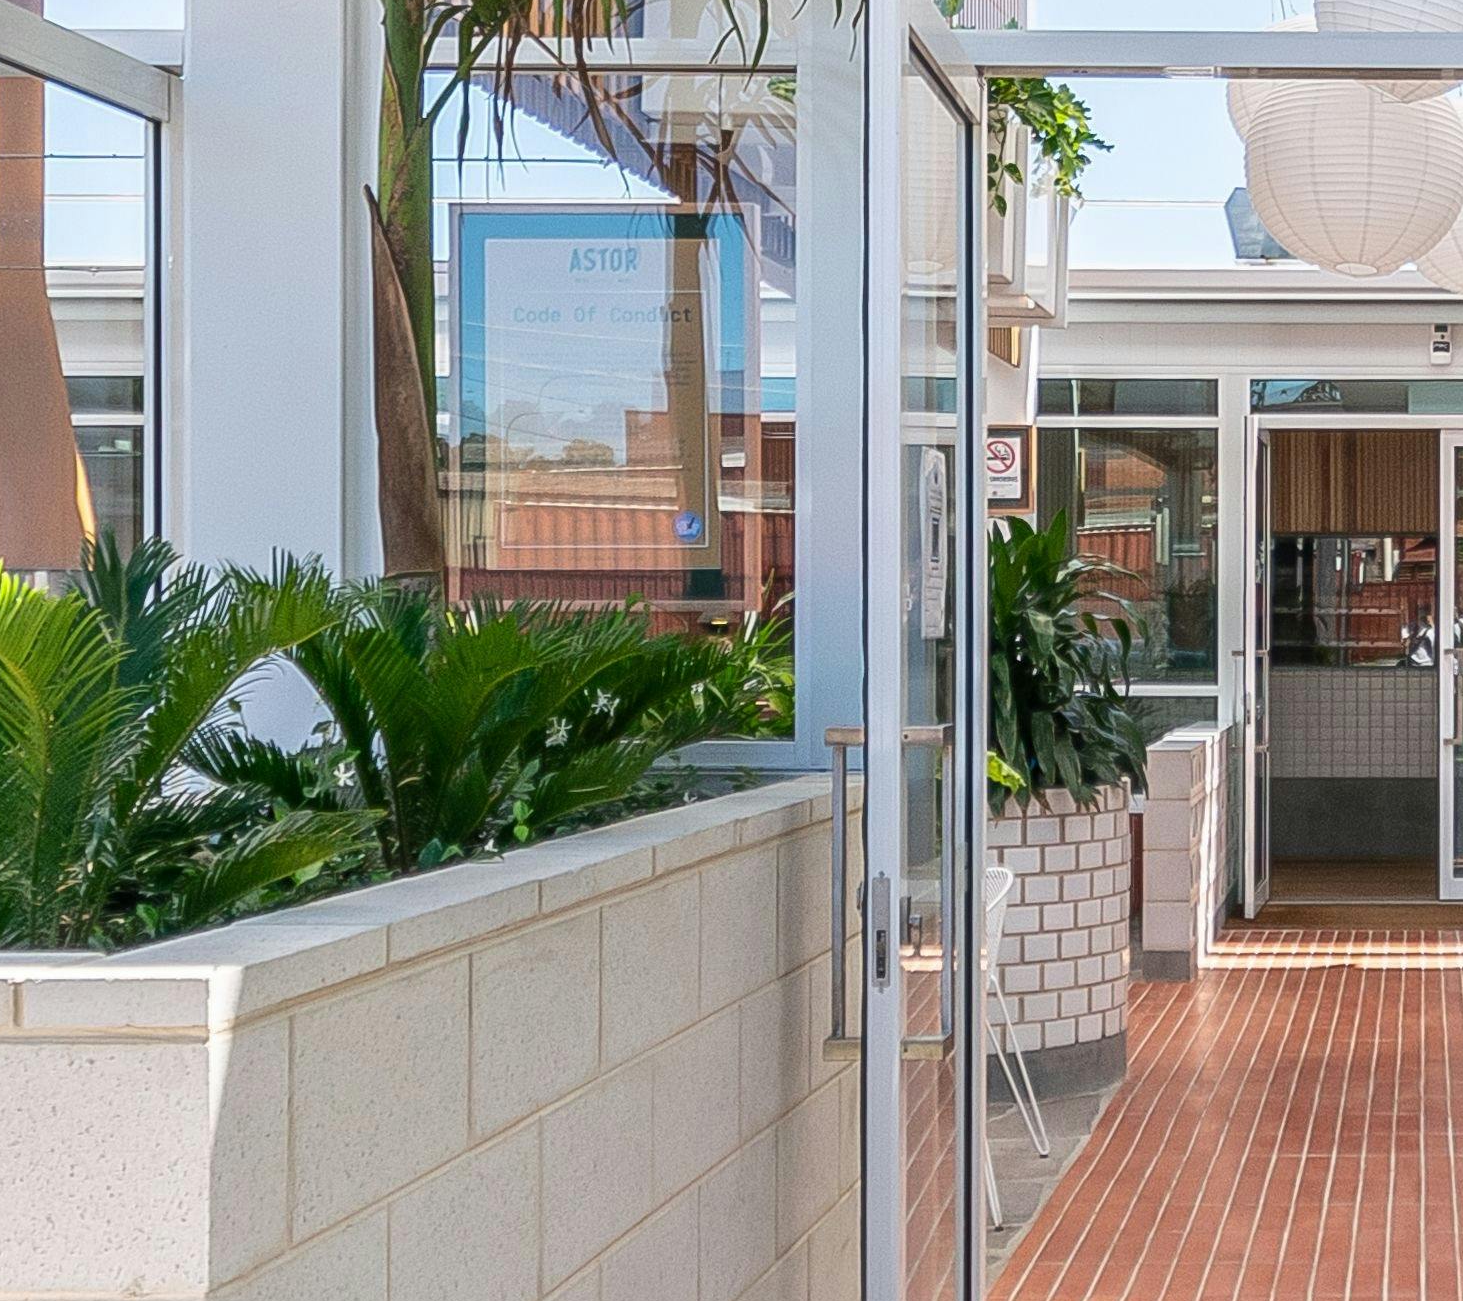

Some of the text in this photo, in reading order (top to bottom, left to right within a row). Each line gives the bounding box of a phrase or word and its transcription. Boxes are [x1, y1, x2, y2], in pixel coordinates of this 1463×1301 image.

[568, 247, 638, 273] ASTOR
[513, 306, 693, 324] Code Of Conduct
